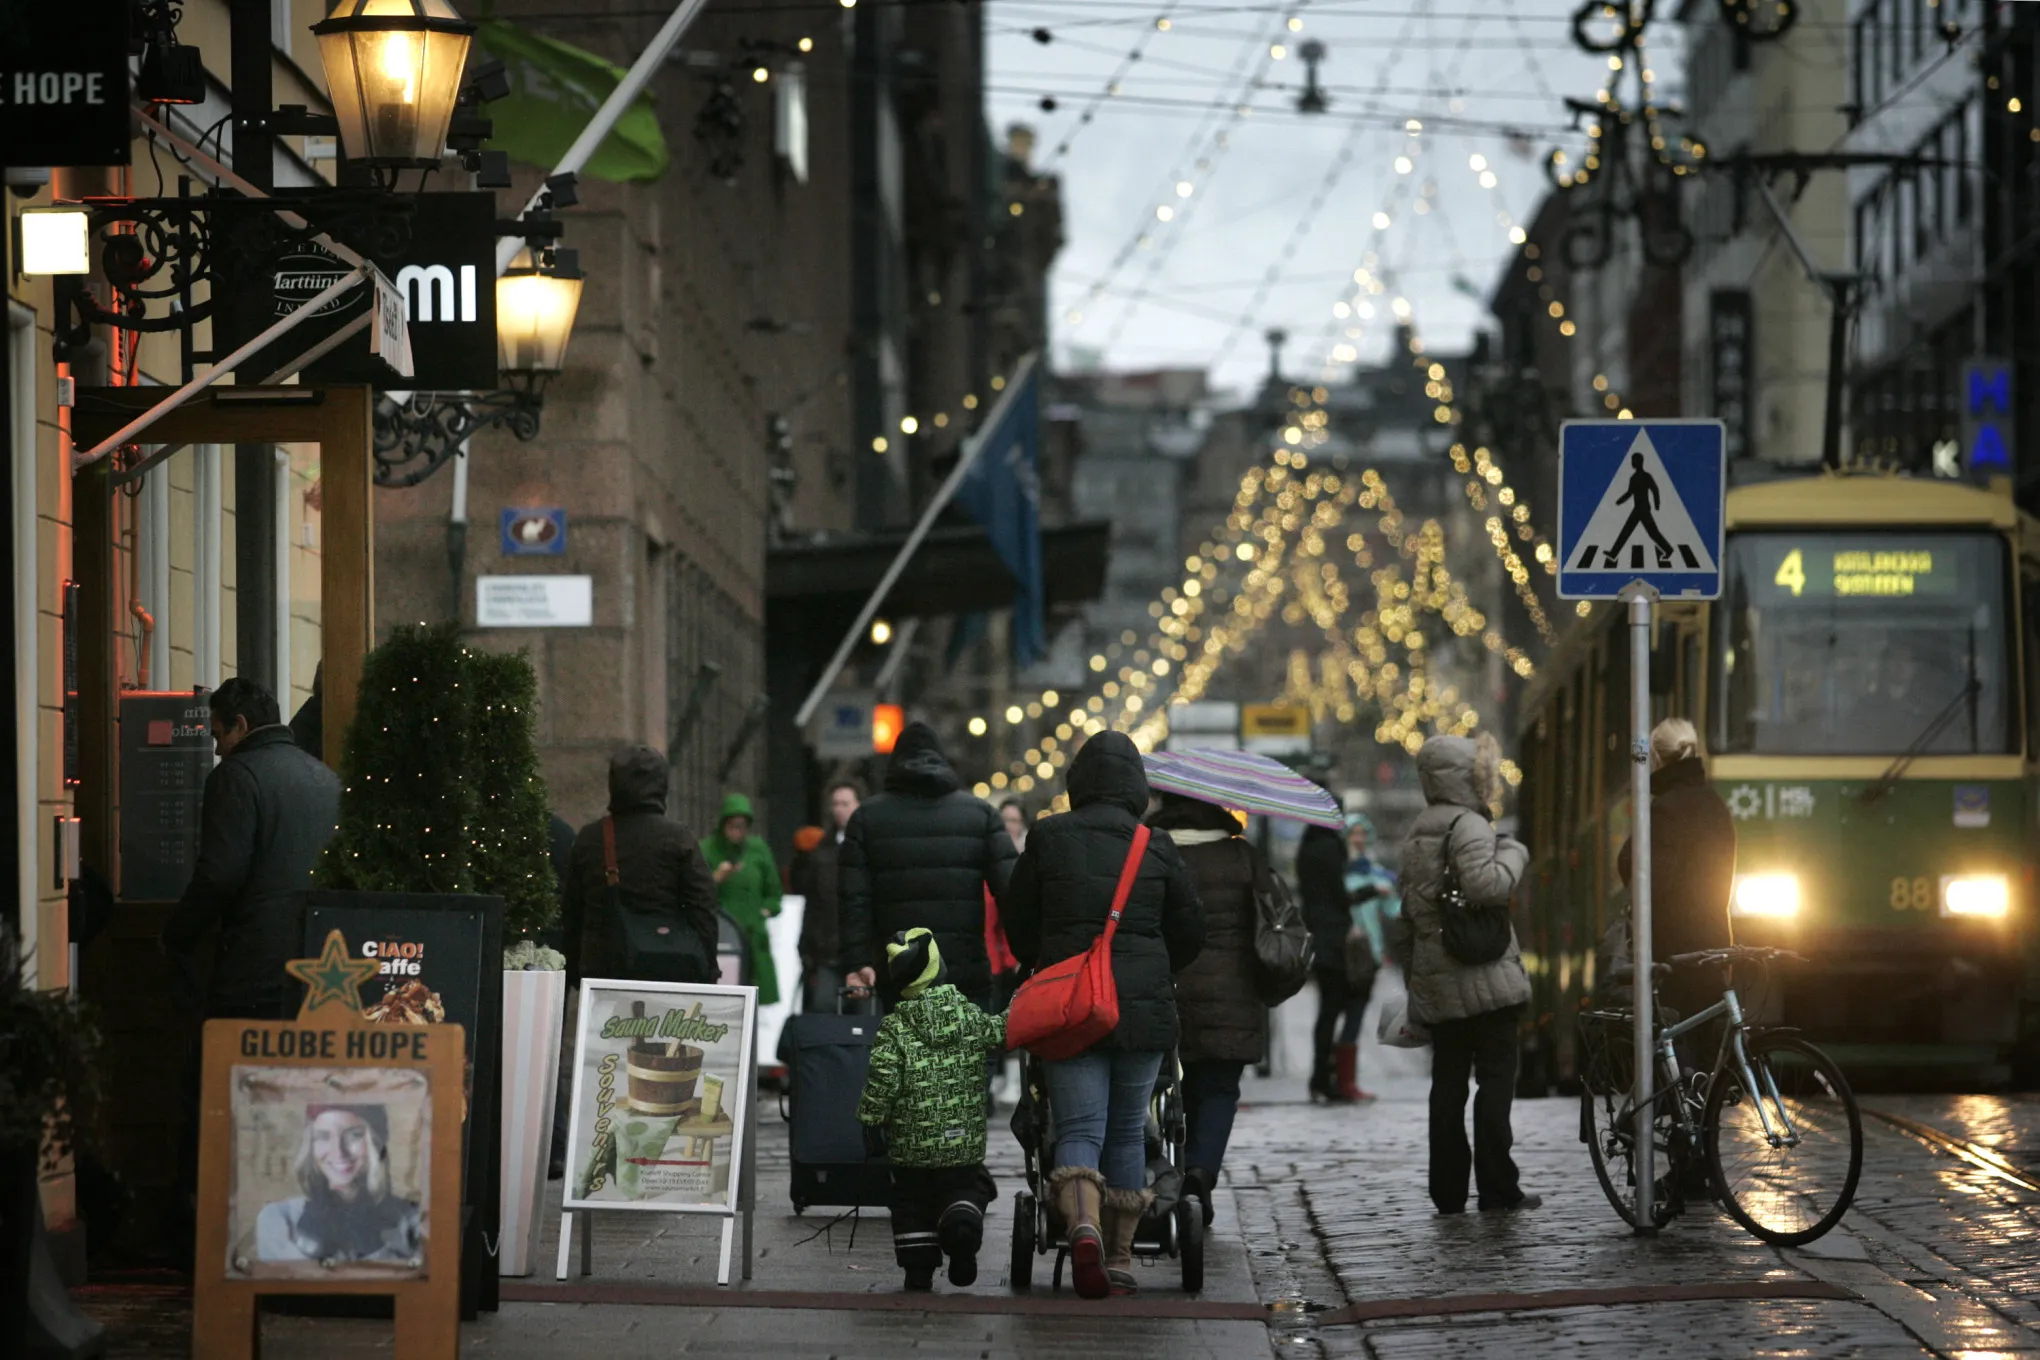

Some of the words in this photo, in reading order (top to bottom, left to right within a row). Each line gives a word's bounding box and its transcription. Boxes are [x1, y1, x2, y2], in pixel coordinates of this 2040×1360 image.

[14, 71, 105, 105] HOPE
[1774, 548, 1807, 597] 4
[1891, 876, 1931, 911] 88
[362, 940, 424, 959] CIAO!
[601, 1015, 660, 1039] Sauna
[658, 1008, 728, 1044] Market
[240, 1028, 336, 1059] GLOBE
[346, 1030, 429, 1060] HOPE
[589, 1053, 620, 1191] Souvenirs
